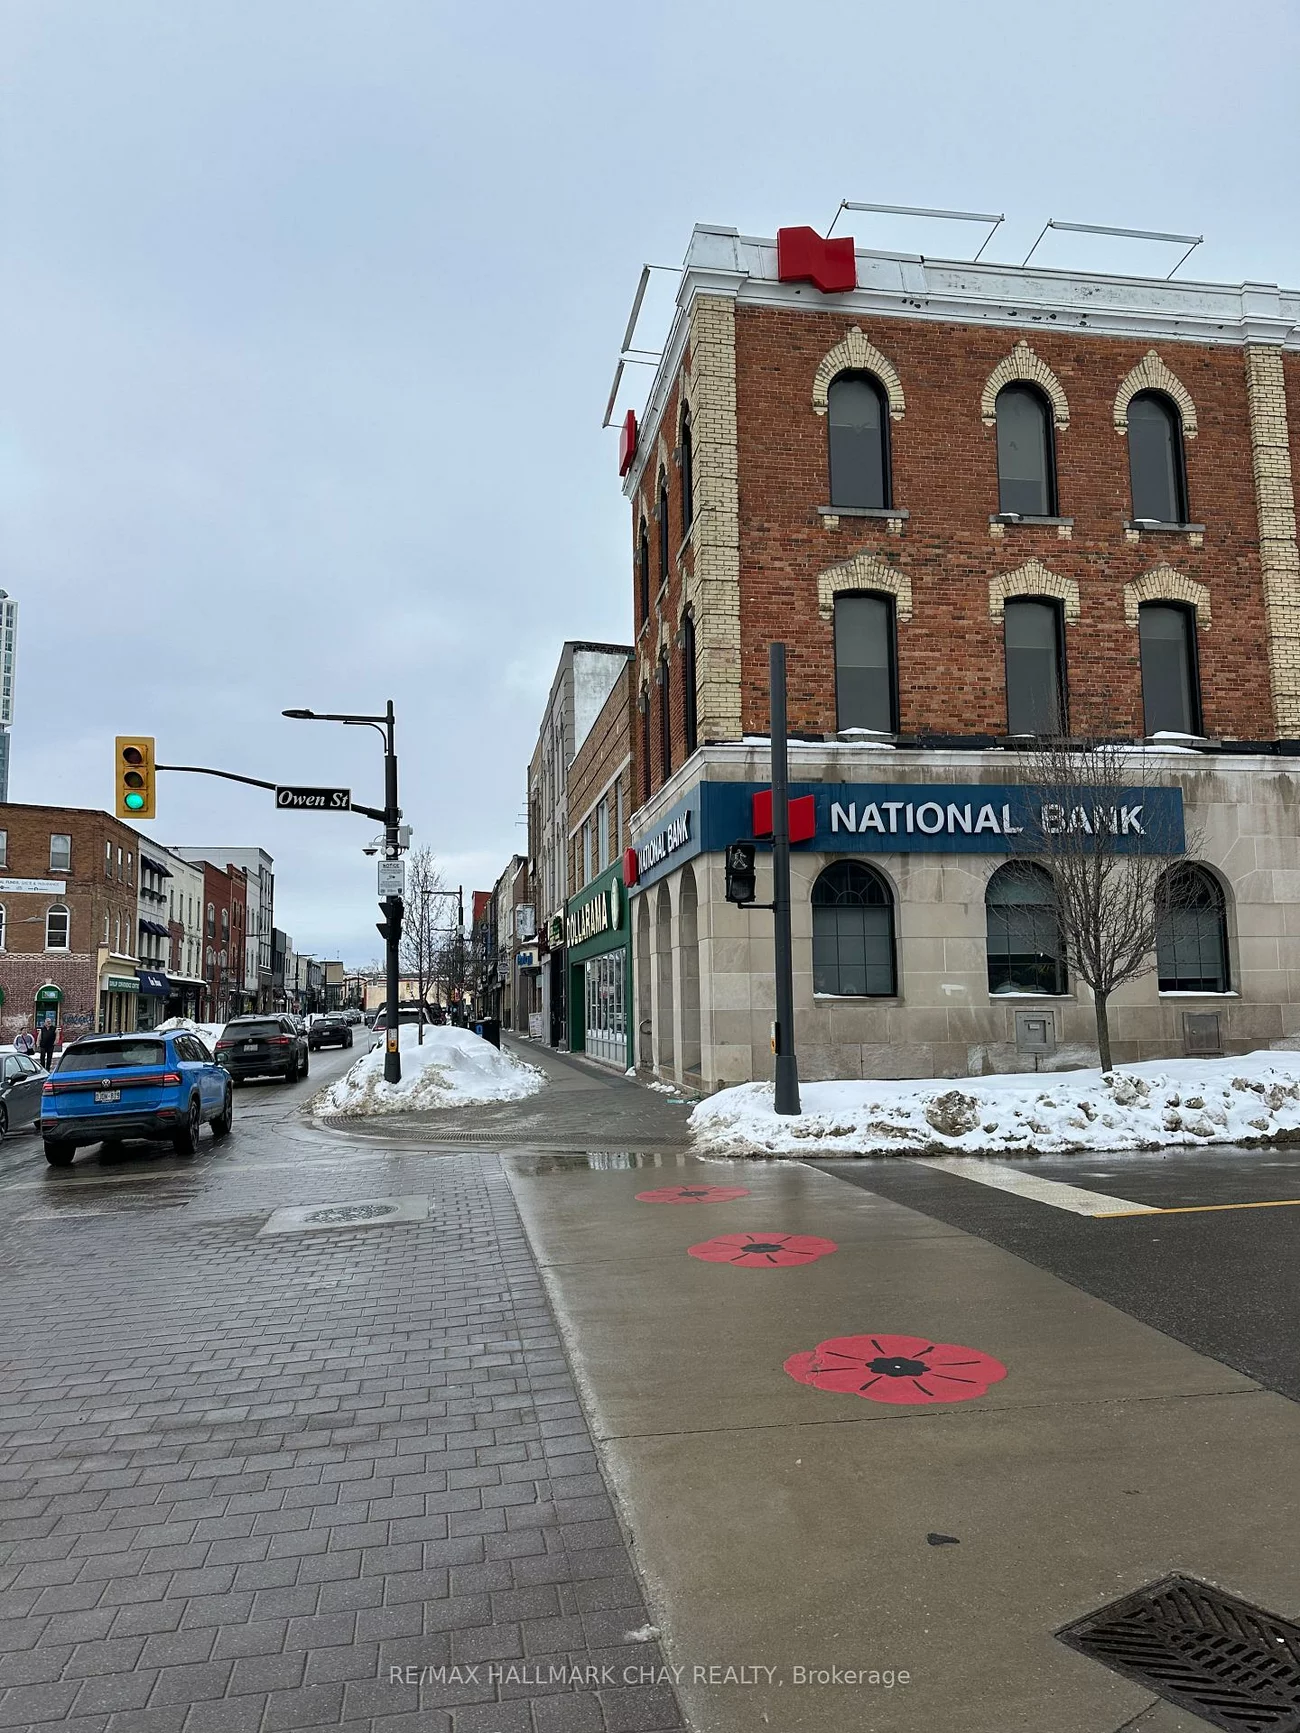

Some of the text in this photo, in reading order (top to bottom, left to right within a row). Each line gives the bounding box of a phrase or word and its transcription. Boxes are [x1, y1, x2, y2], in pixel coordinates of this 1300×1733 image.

[278, 790, 349, 807] Owen St
[831, 802, 1147, 836] NATIONAL BANK
[638, 810, 689, 876] NATIONAL BANK
[566, 891, 608, 949] DOLLARAMA
